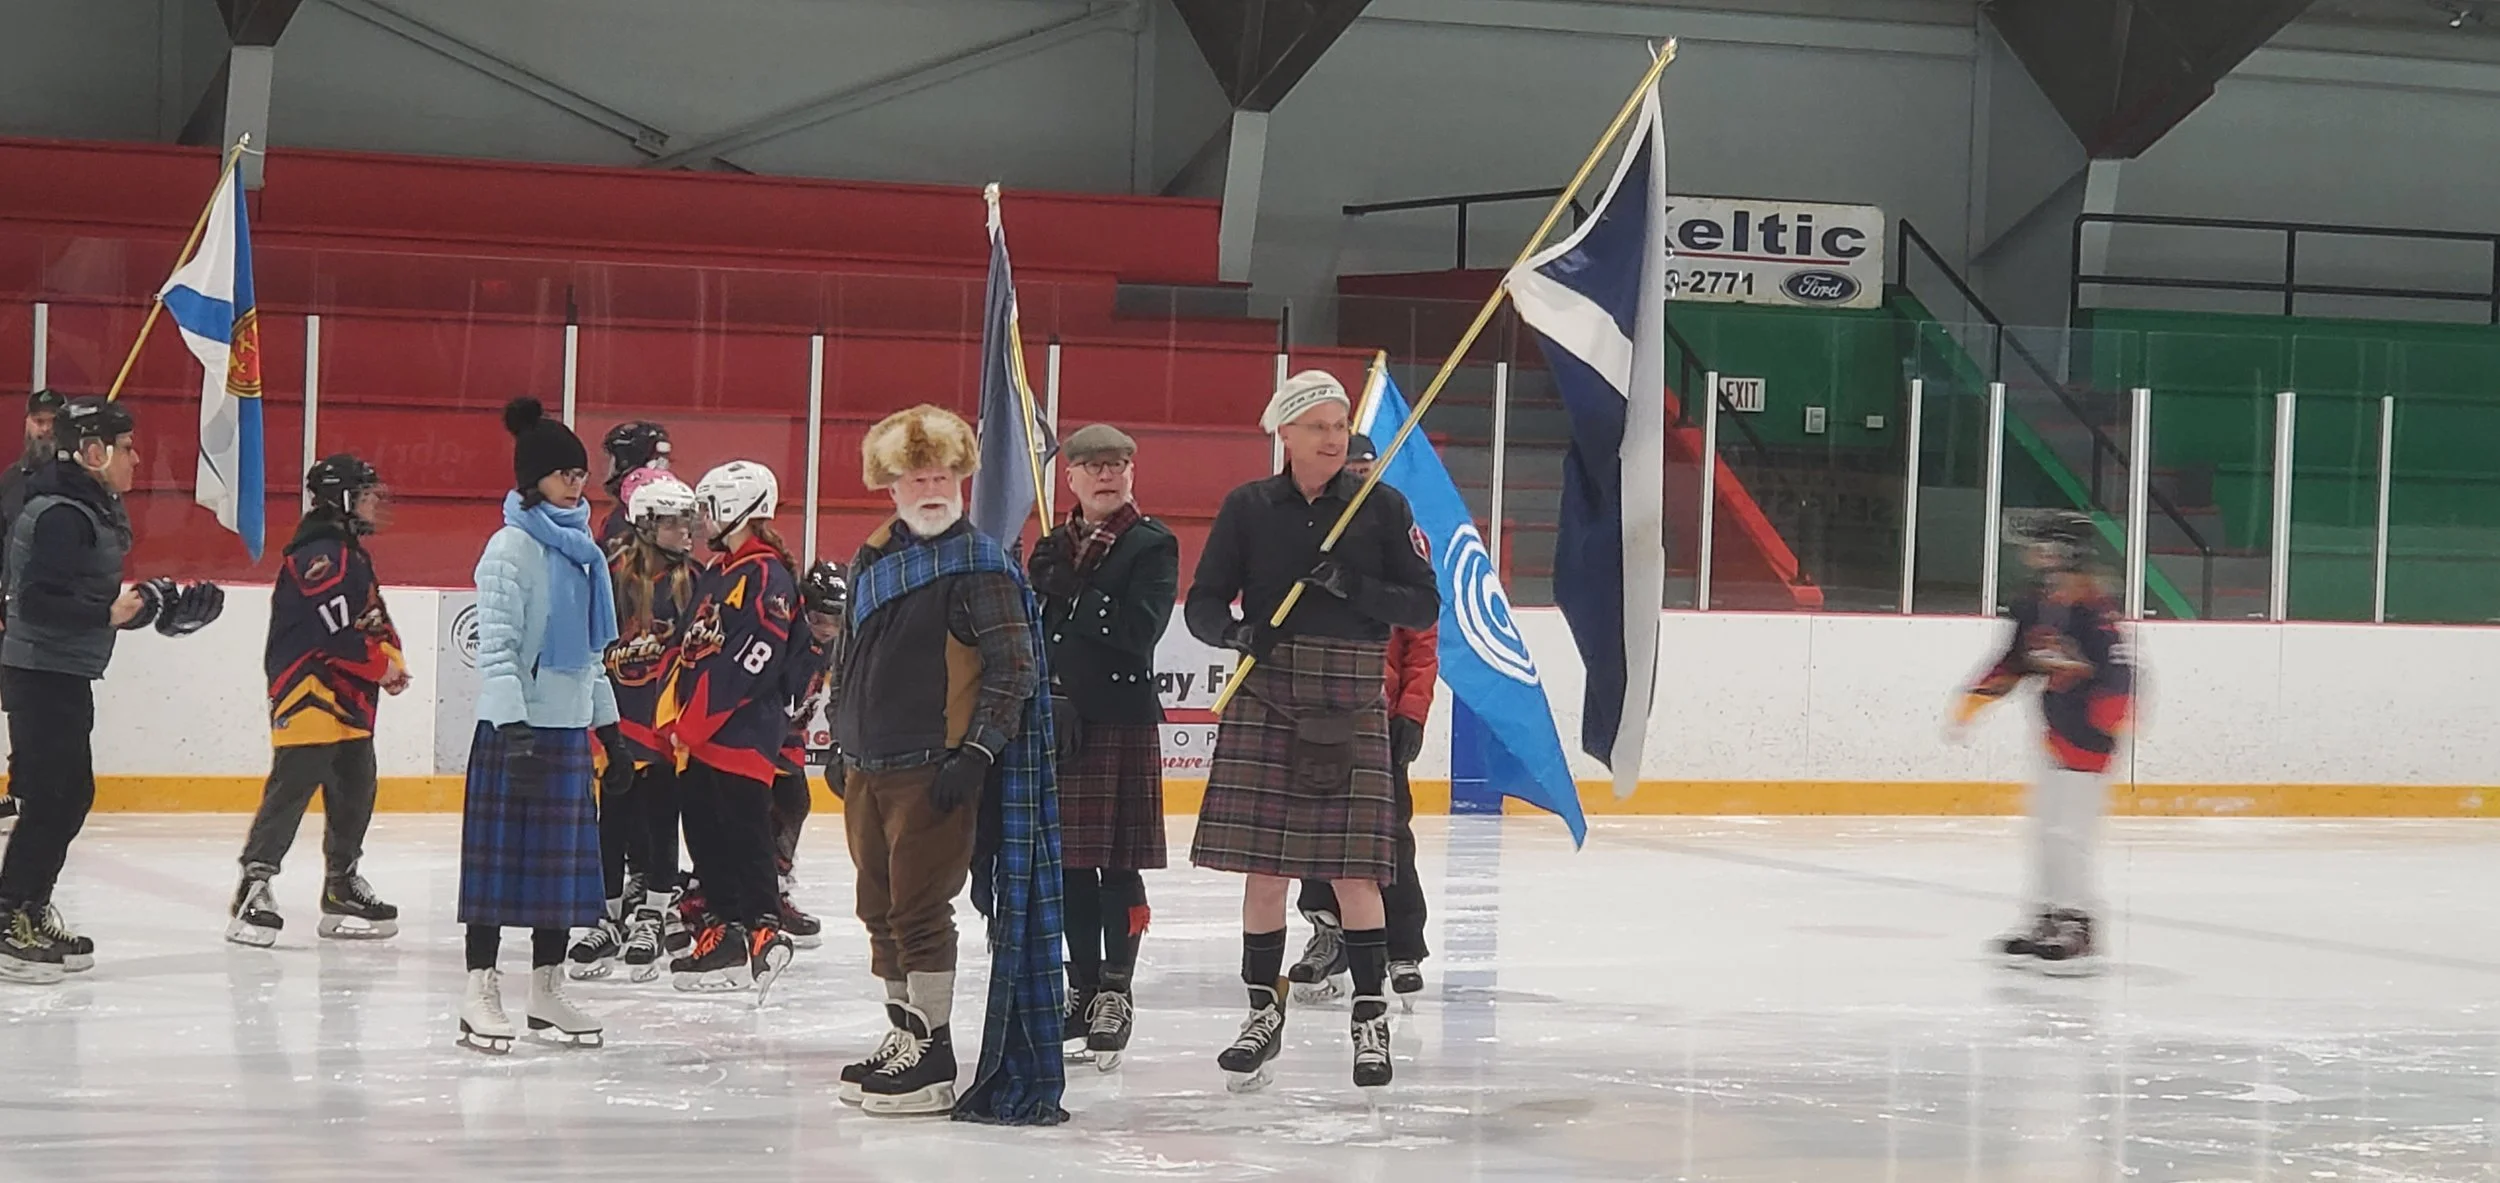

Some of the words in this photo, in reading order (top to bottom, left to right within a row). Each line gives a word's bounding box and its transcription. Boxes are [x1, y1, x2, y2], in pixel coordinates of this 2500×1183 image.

[1799, 275, 1842, 297] Ford
[1726, 381, 1758, 408] EXIT
[724, 575, 748, 609] A
[317, 594, 350, 635] 17
[733, 633, 773, 675] 18
